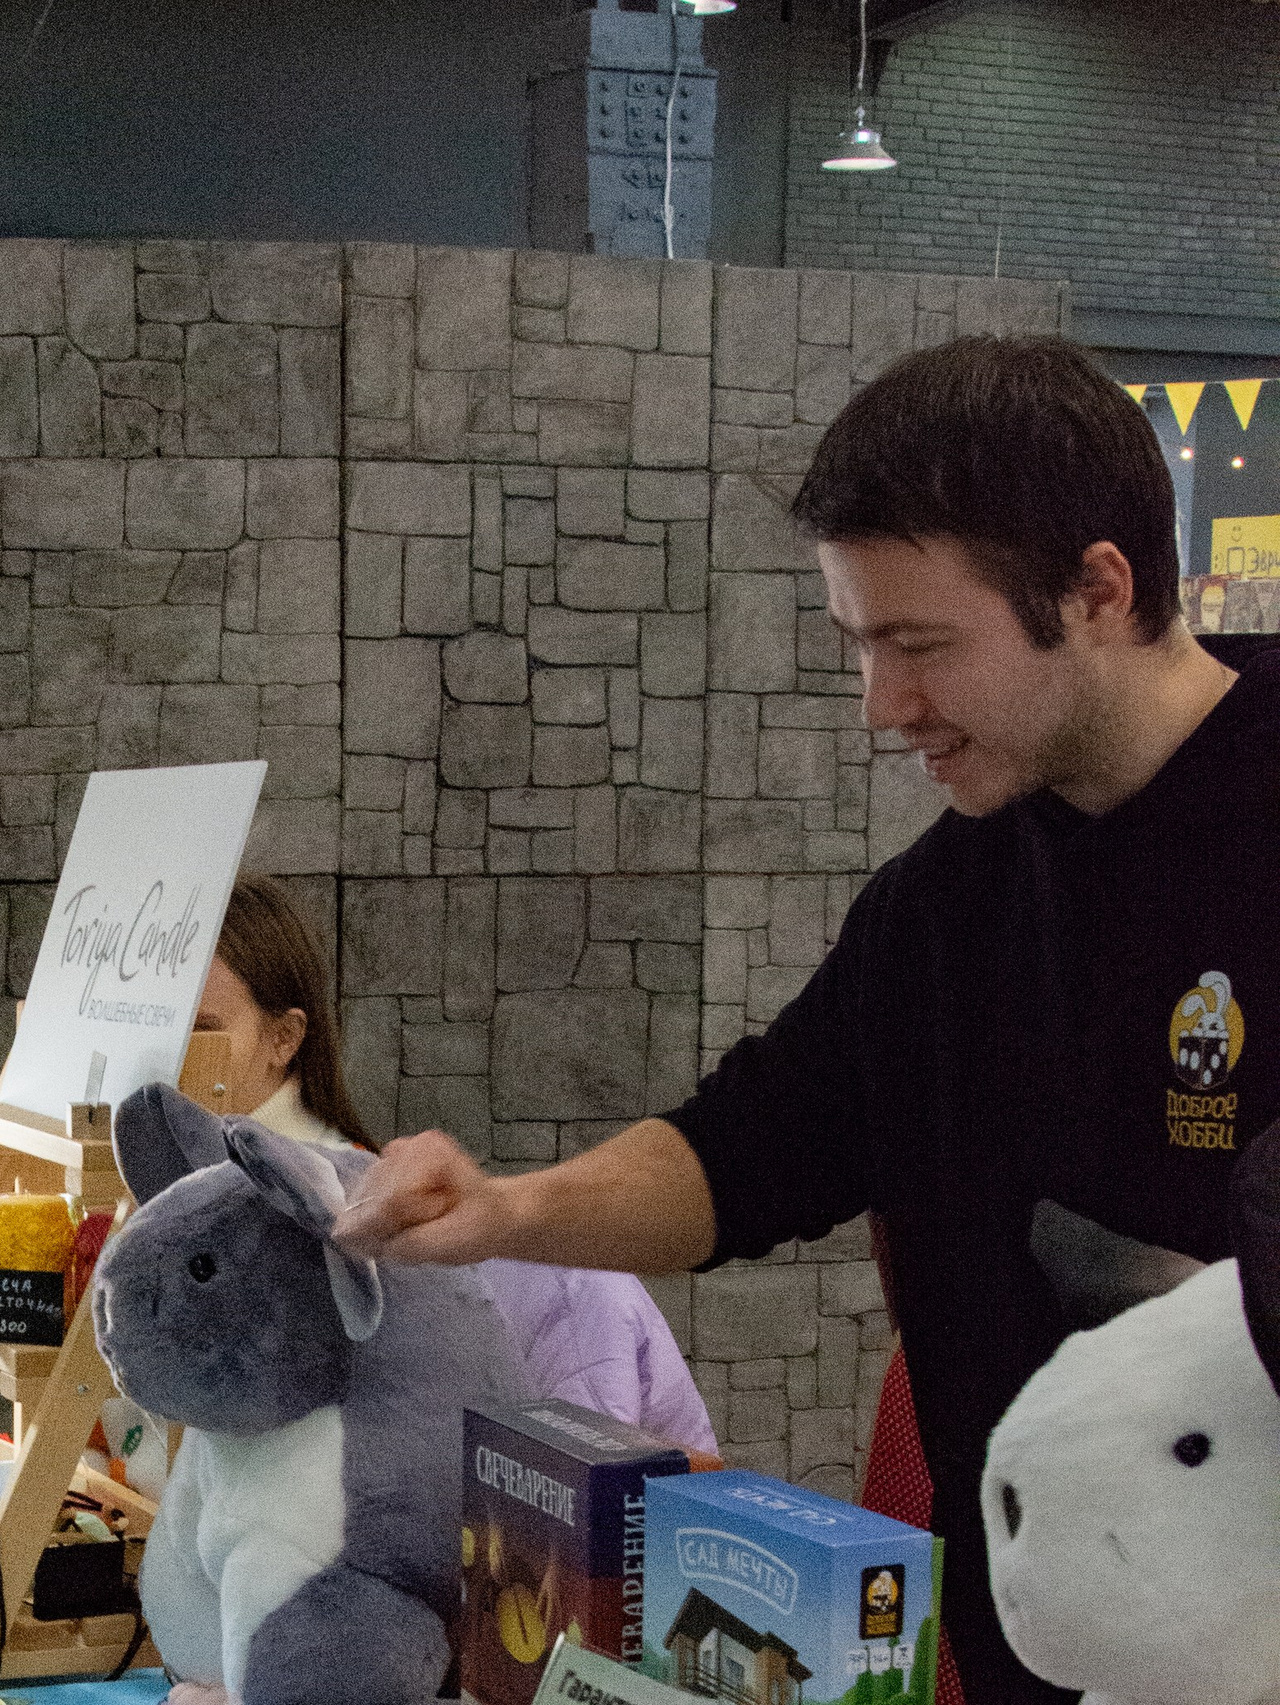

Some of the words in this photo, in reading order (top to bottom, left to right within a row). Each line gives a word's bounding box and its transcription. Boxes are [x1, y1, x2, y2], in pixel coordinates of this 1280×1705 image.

[119, 880, 201, 982] Candle
[87, 999, 141, 1024] ВОЛШЕБНЫЕ
[143, 1003, 176, 1027] СВЕЧИ
[1165, 1089, 1238, 1120] ДОБРОЕ
[1165, 1118, 1237, 1150] ХОББИ
[475, 1445, 576, 1527] СВЕЧЕВАРЕНИЕ
[684, 1540, 719, 1569] САД
[726, 1547, 788, 1602] МЕЧТЫ
